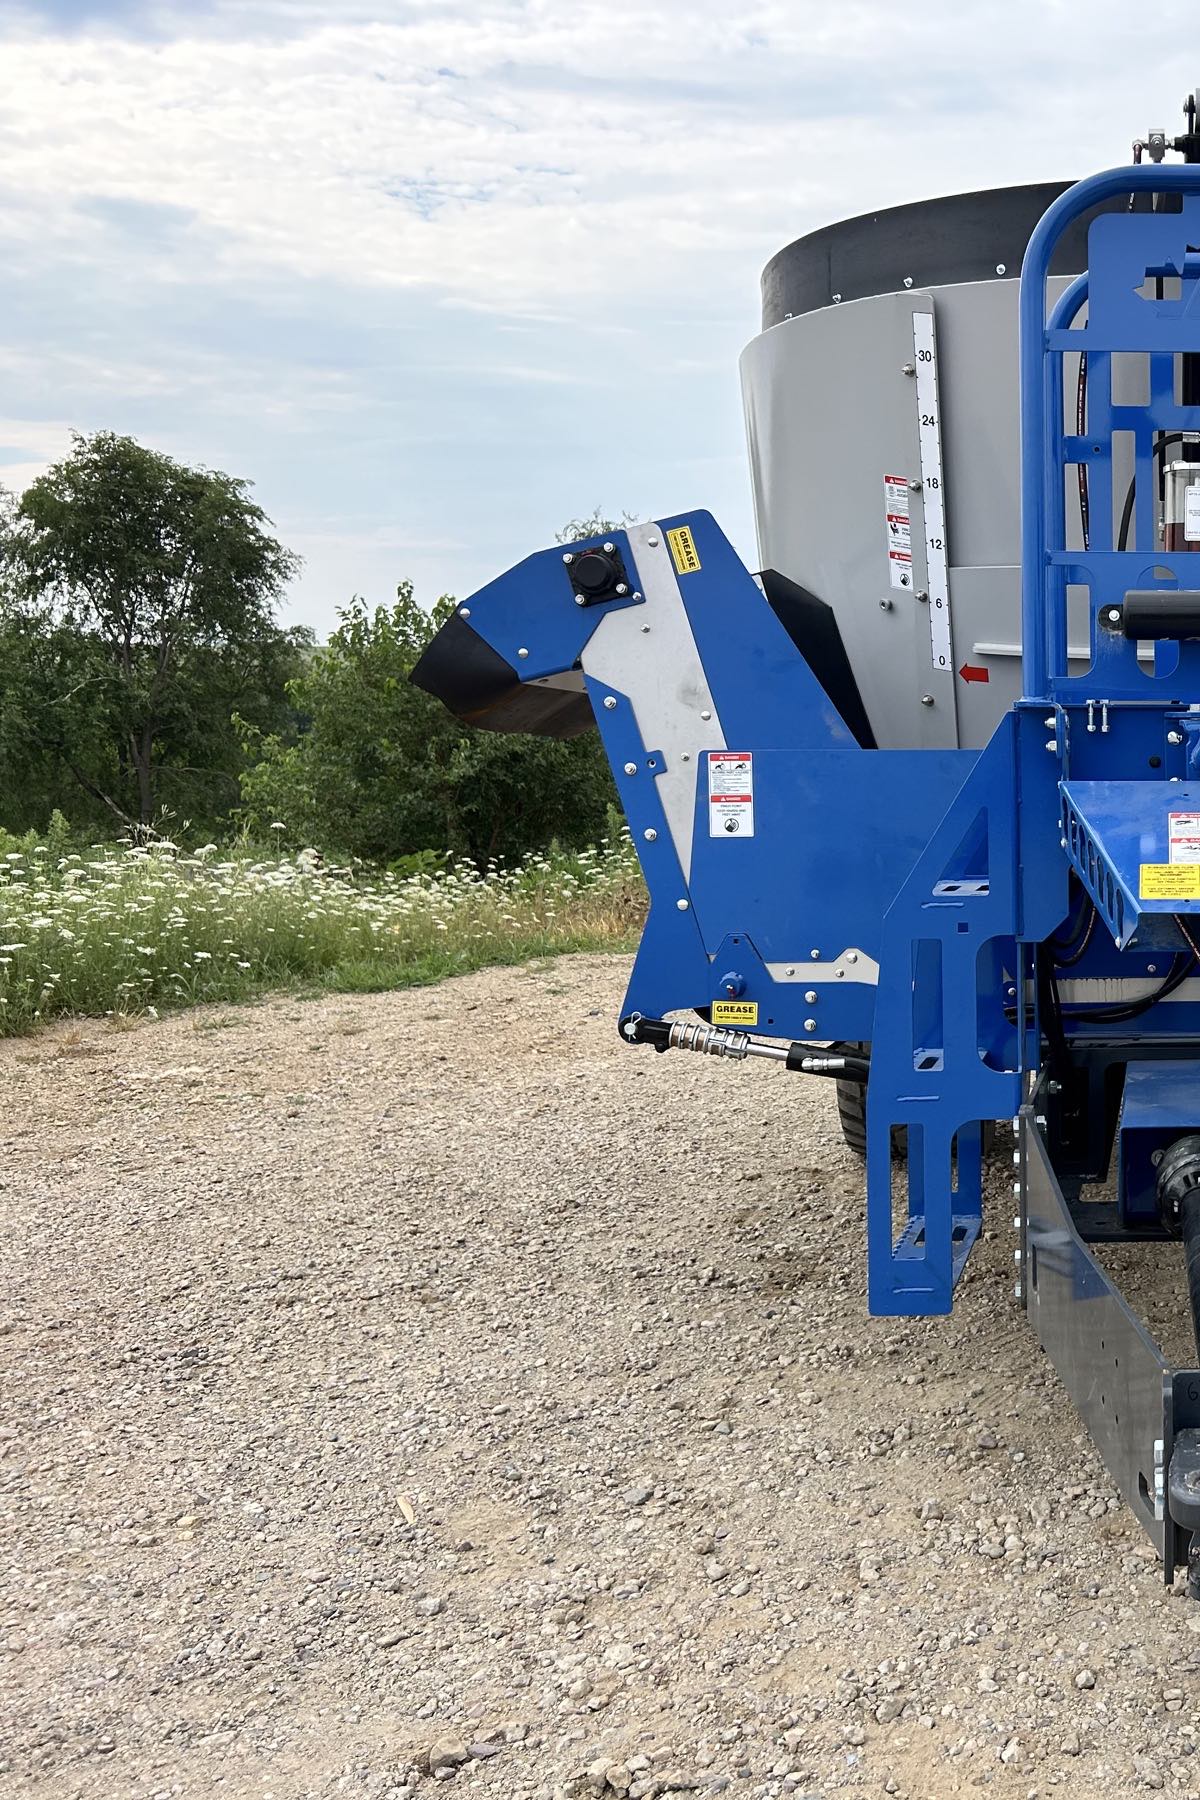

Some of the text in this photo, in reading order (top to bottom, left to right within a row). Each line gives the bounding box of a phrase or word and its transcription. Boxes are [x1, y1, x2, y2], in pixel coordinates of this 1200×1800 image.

[918, 350, 932, 362] 30
[922, 414, 936, 427] 24
[926, 477, 939, 489] 18
[680, 531, 696, 569] GREASE
[929, 538, 943, 550] 12
[935, 597, 943, 609] 6
[938, 655, 946, 666] 0
[716, 1005, 754, 1013] GREASE
